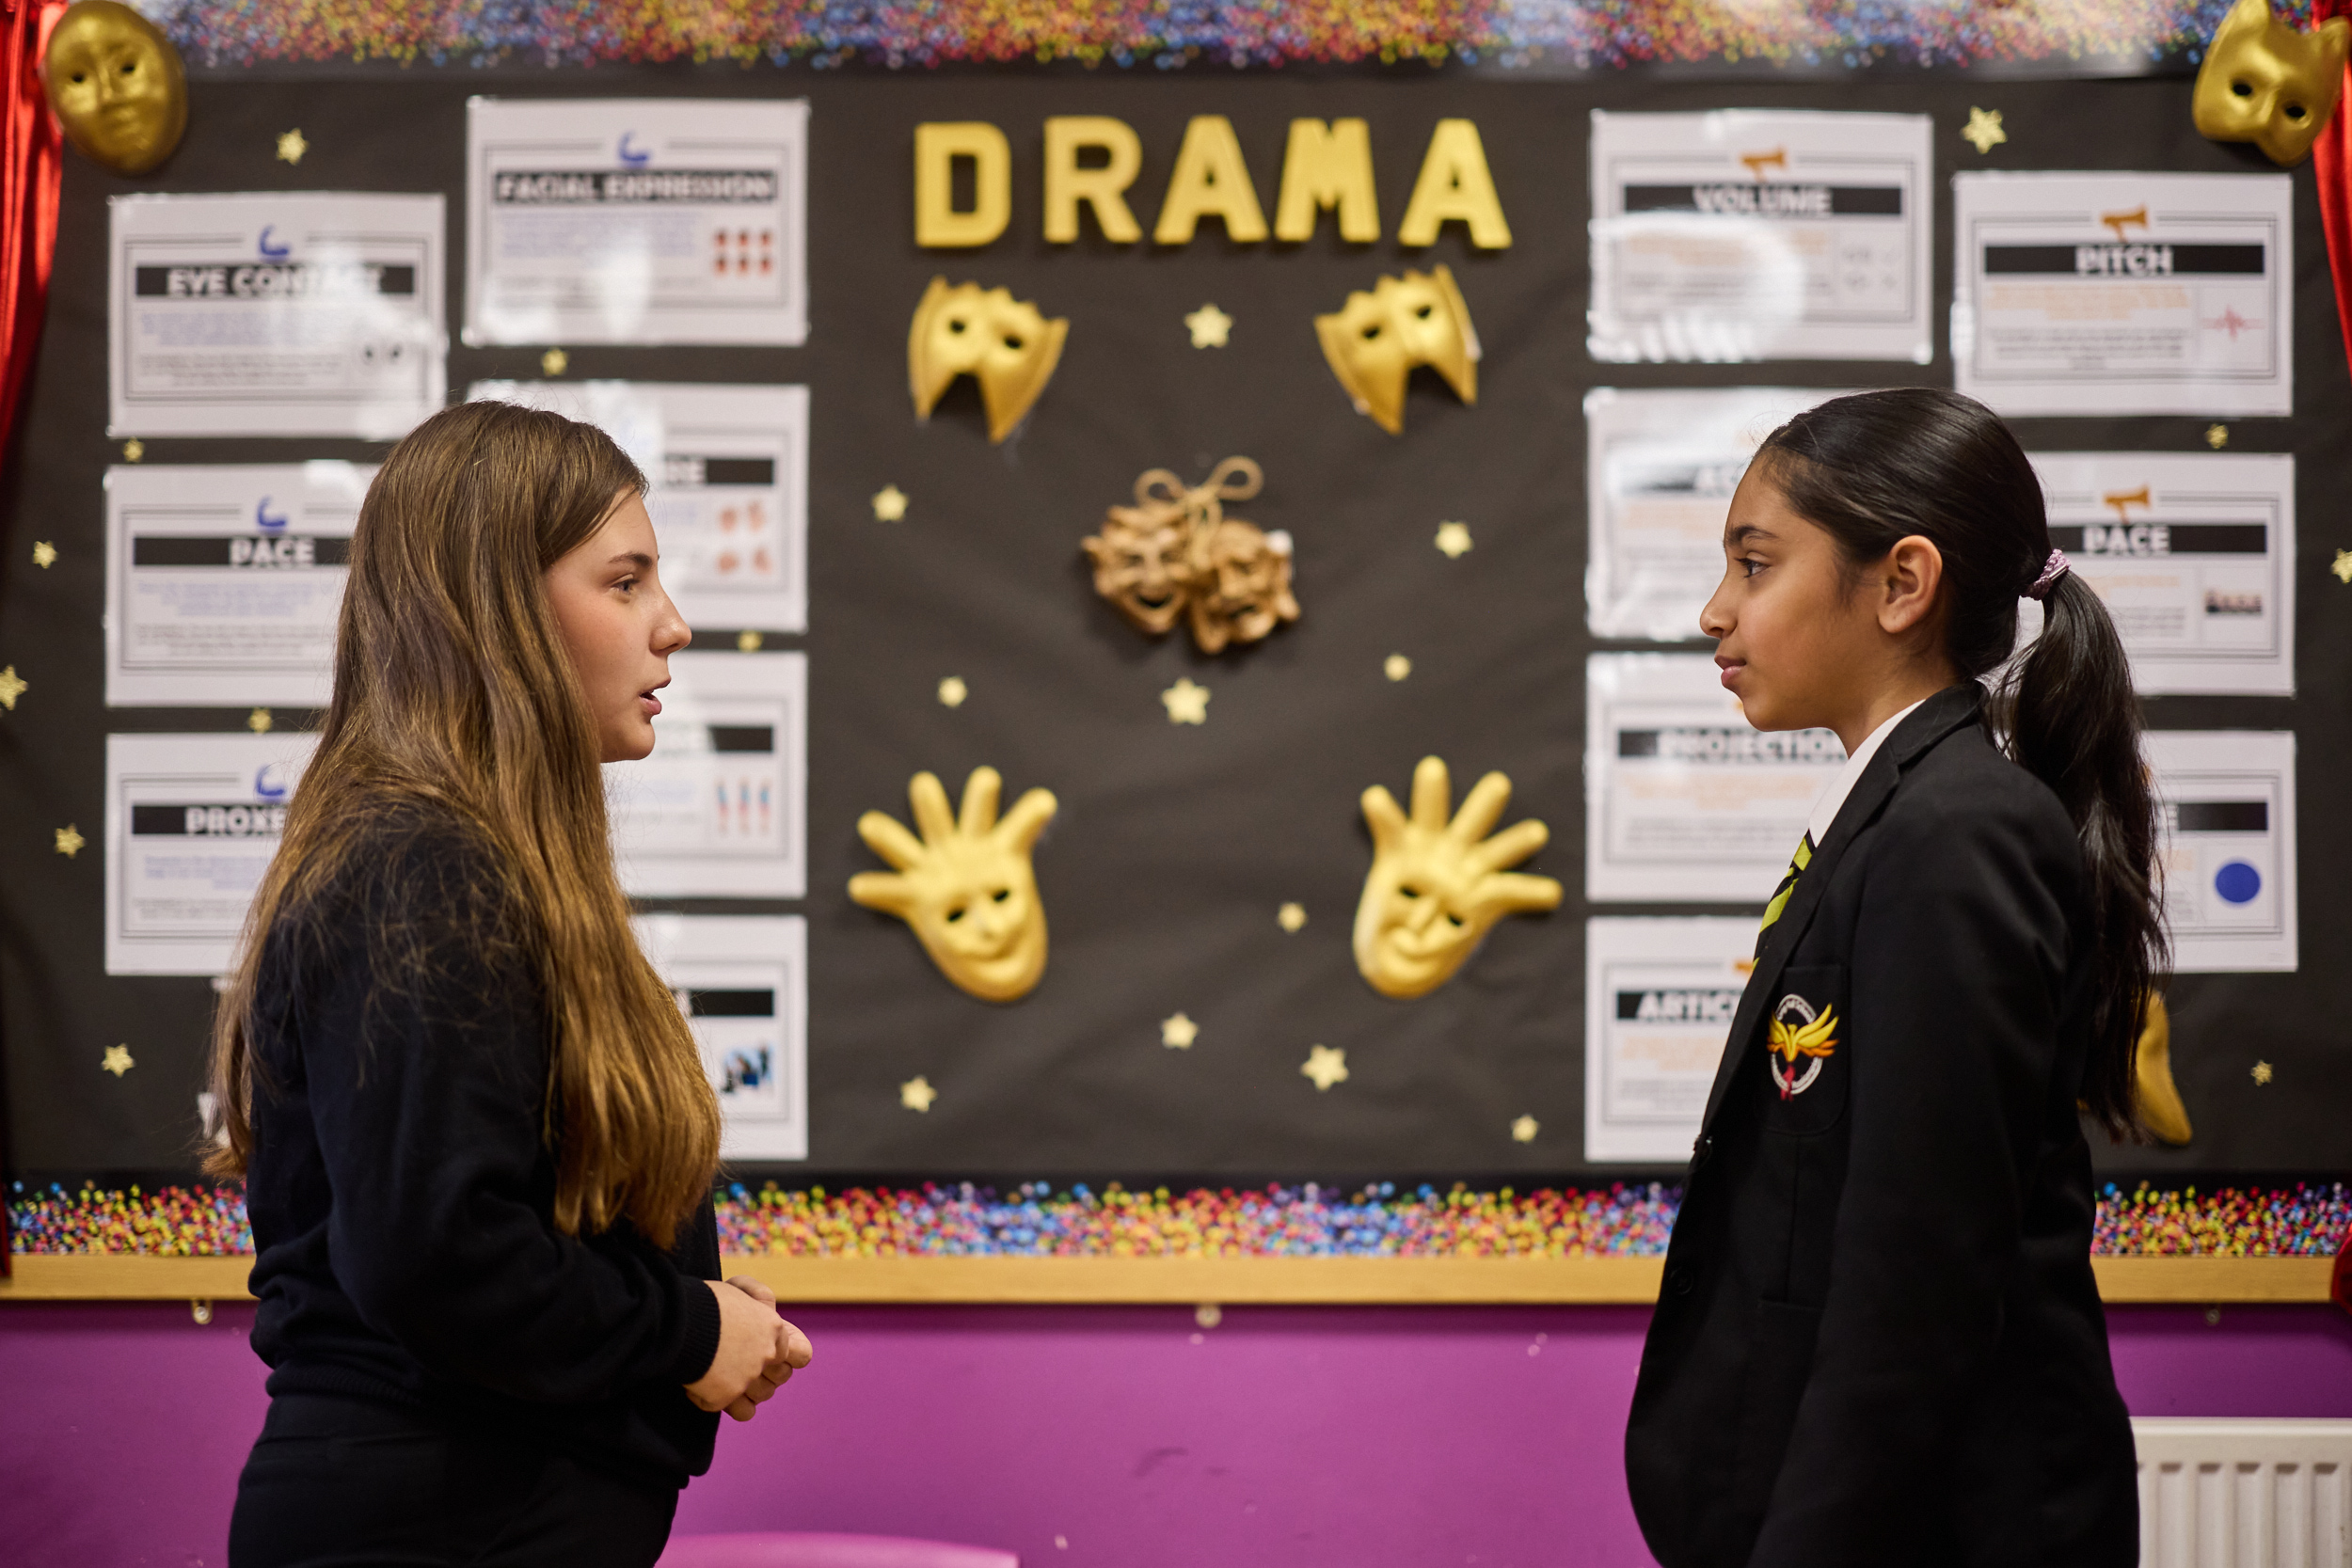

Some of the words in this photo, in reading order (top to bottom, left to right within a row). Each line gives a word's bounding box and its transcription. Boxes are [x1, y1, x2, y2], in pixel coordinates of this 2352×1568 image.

[914, 113, 1514, 250] DRAMA
[1692, 184, 1833, 216] VOLUME
[2074, 244, 2175, 277] PITCH
[166, 265, 227, 297] EYE
[228, 536, 316, 568] PACE
[2081, 524, 2172, 555] PACE
